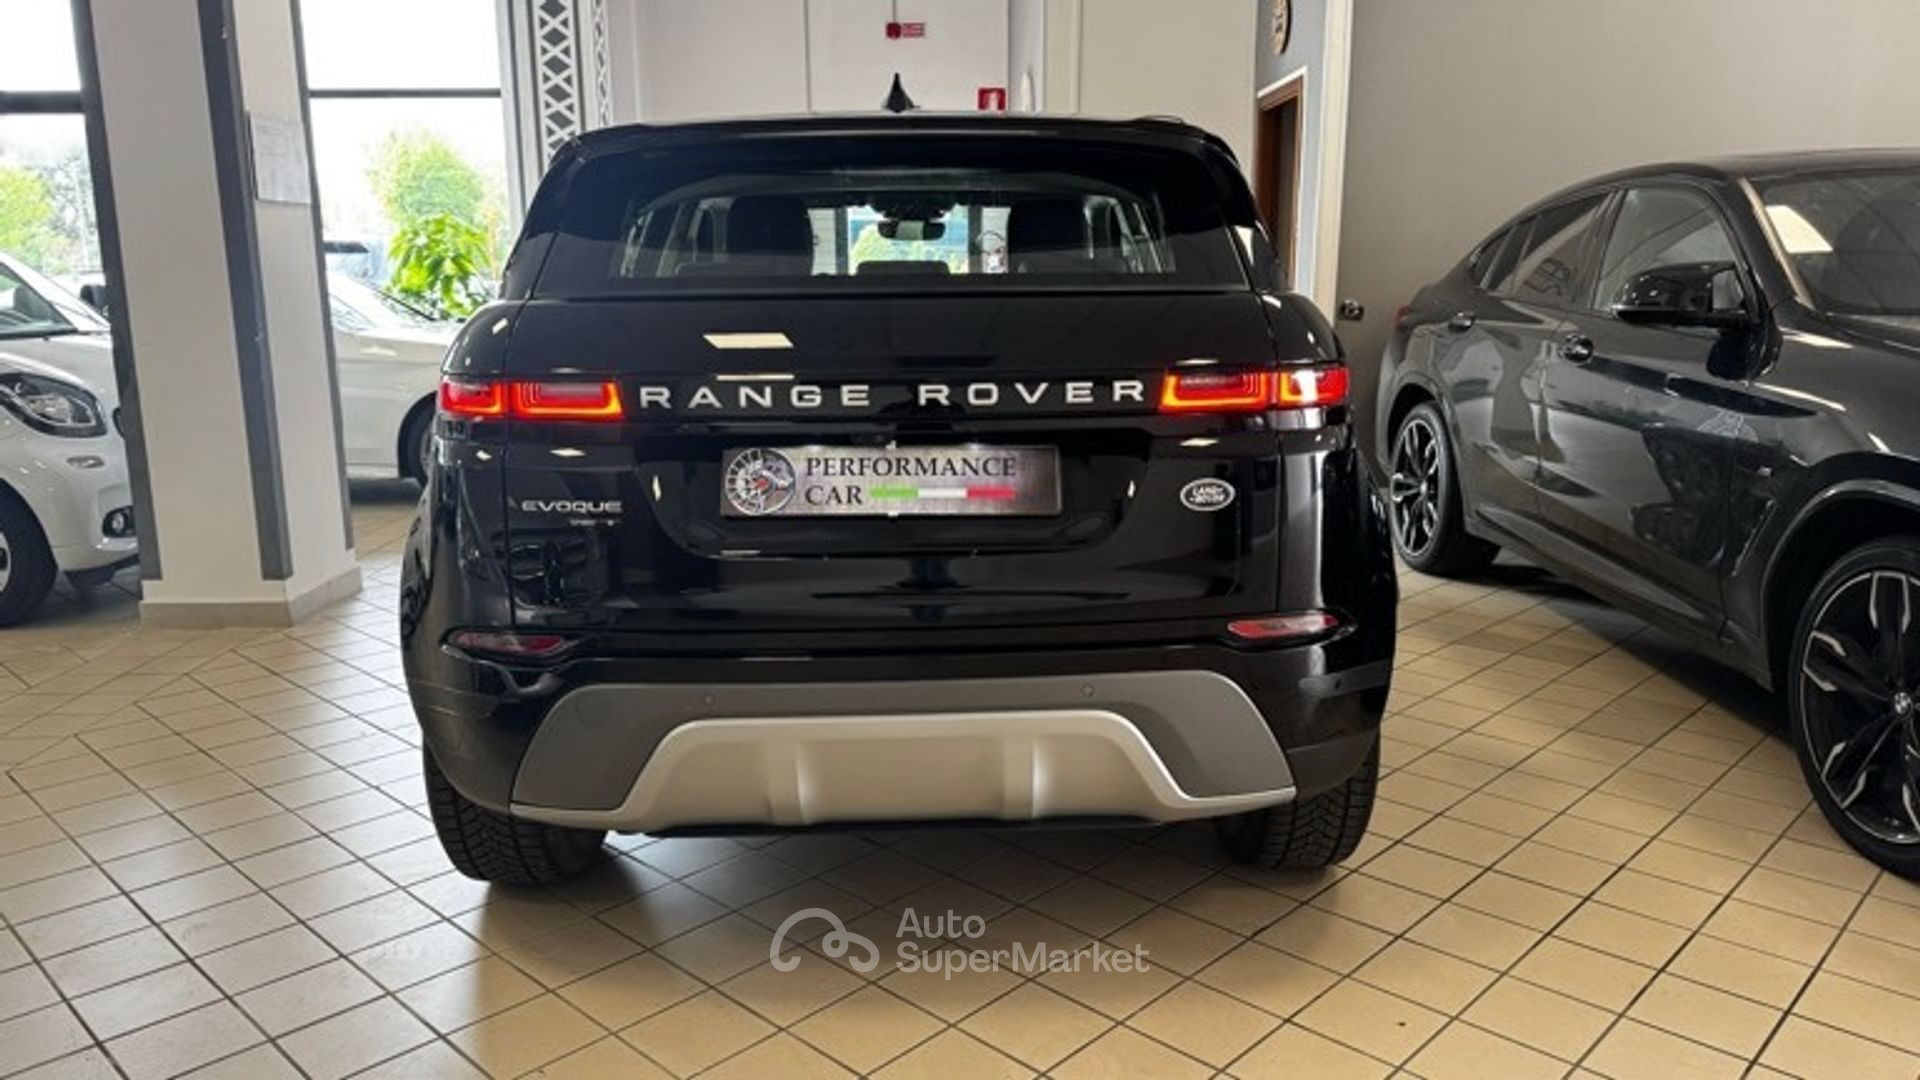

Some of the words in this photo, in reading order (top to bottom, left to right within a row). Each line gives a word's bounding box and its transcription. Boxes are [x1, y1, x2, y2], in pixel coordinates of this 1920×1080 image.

[639, 384, 871, 409] RANGE
[917, 380, 1146, 406] ROVER
[805, 457, 1018, 478] PERFORMANCE
[805, 485, 864, 506] CAR
[521, 500, 623, 514] EVOQUE
